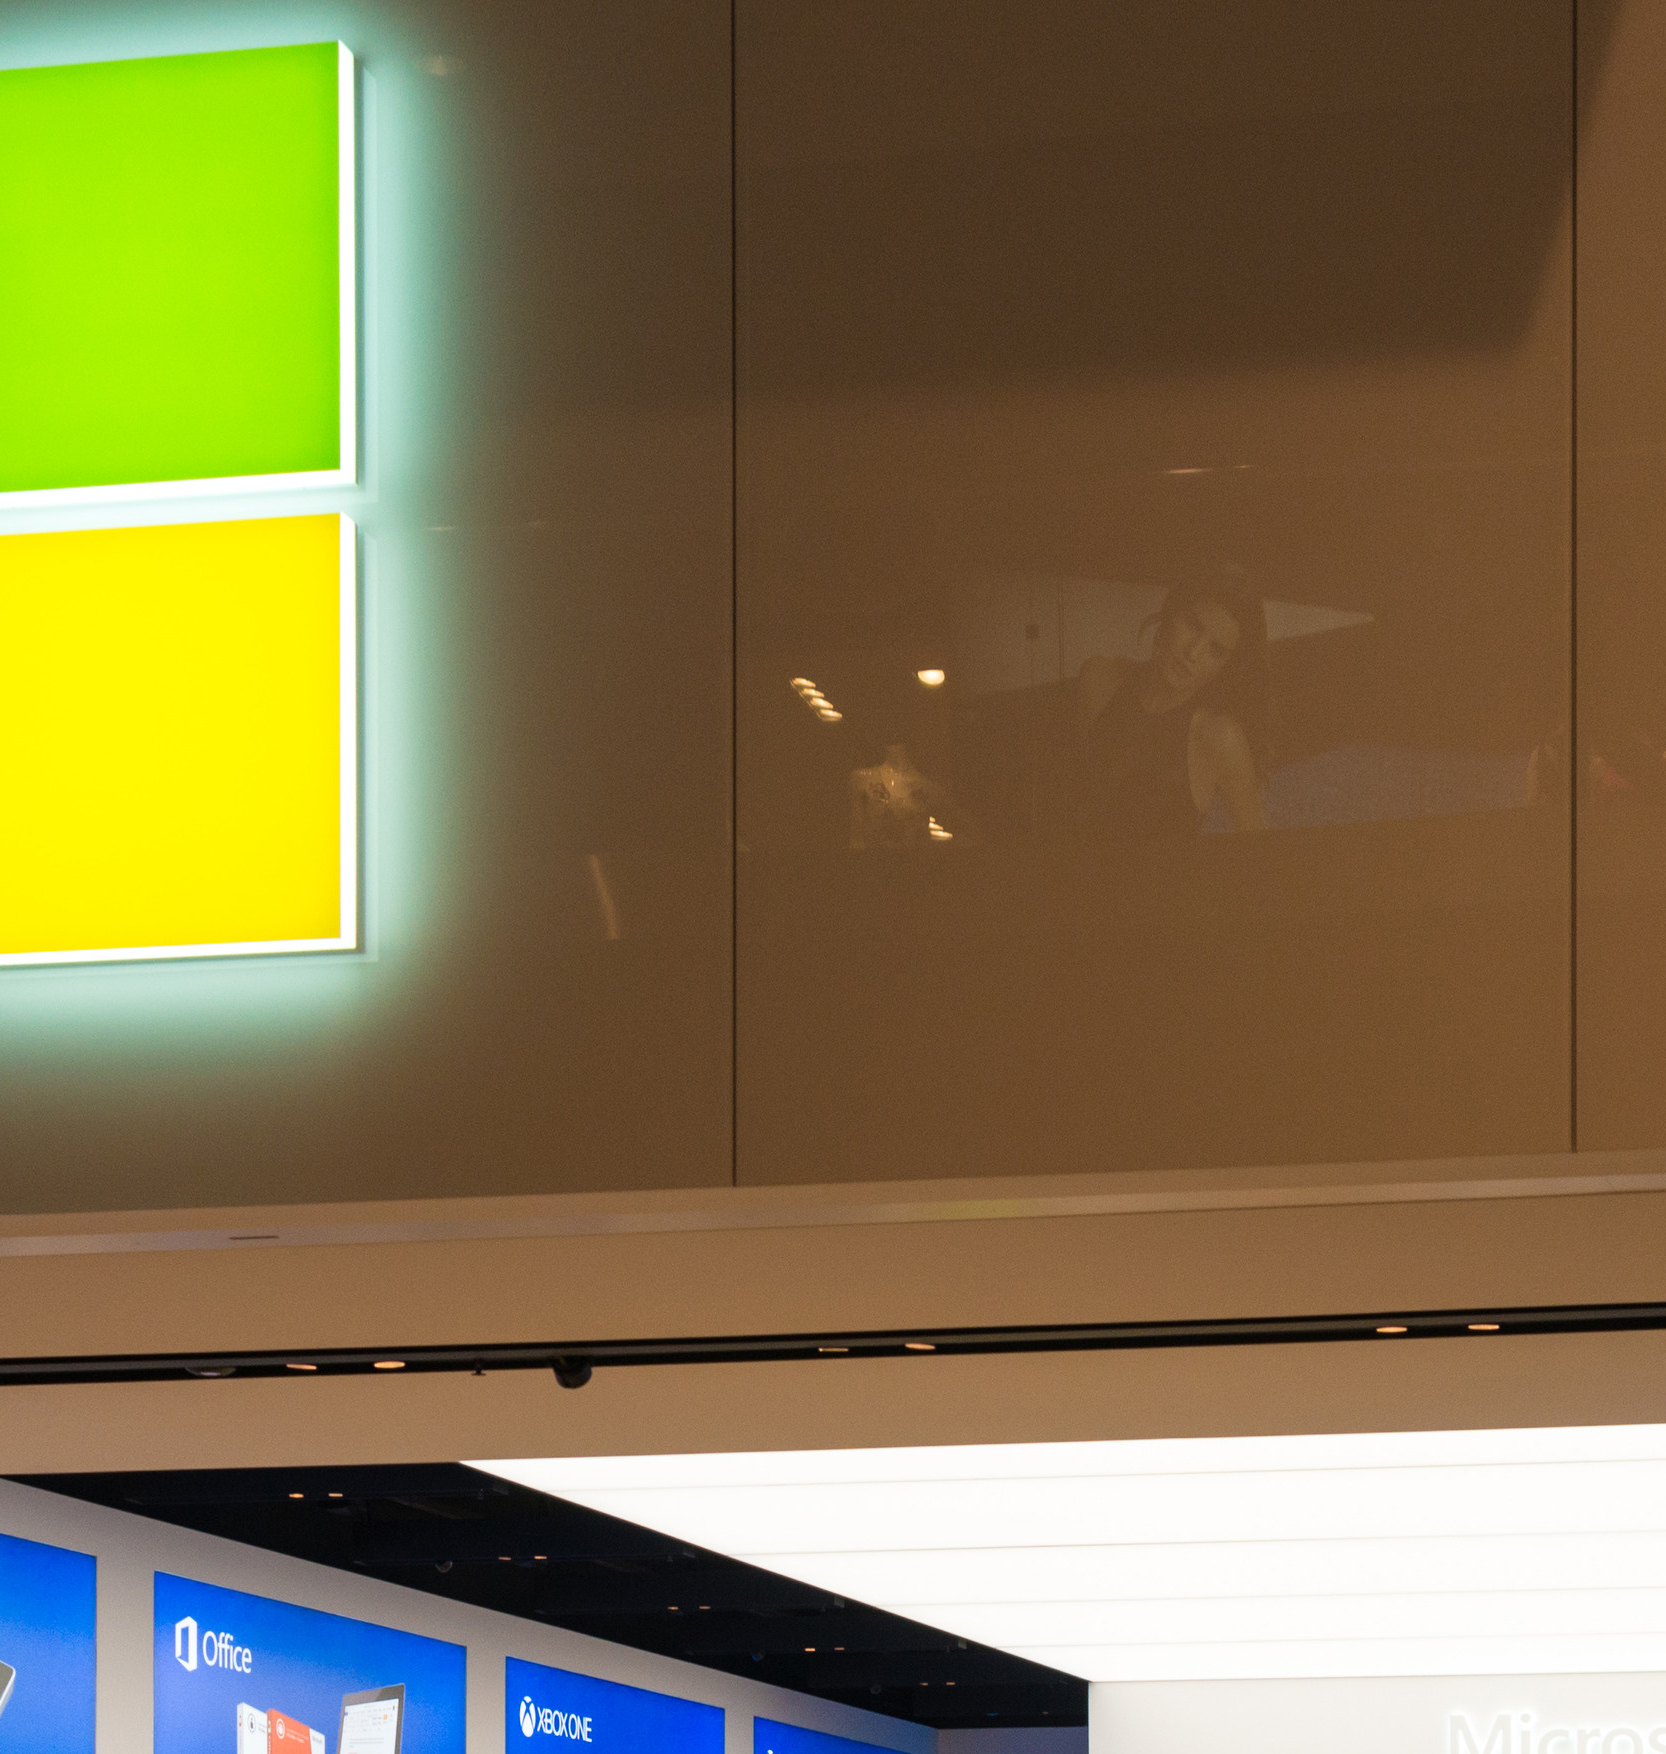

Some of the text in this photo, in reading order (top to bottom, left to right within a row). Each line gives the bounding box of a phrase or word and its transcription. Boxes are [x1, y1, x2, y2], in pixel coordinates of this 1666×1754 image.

[202, 1631, 252, 1673] Office
[537, 1706, 592, 1742] XBOX ONE
